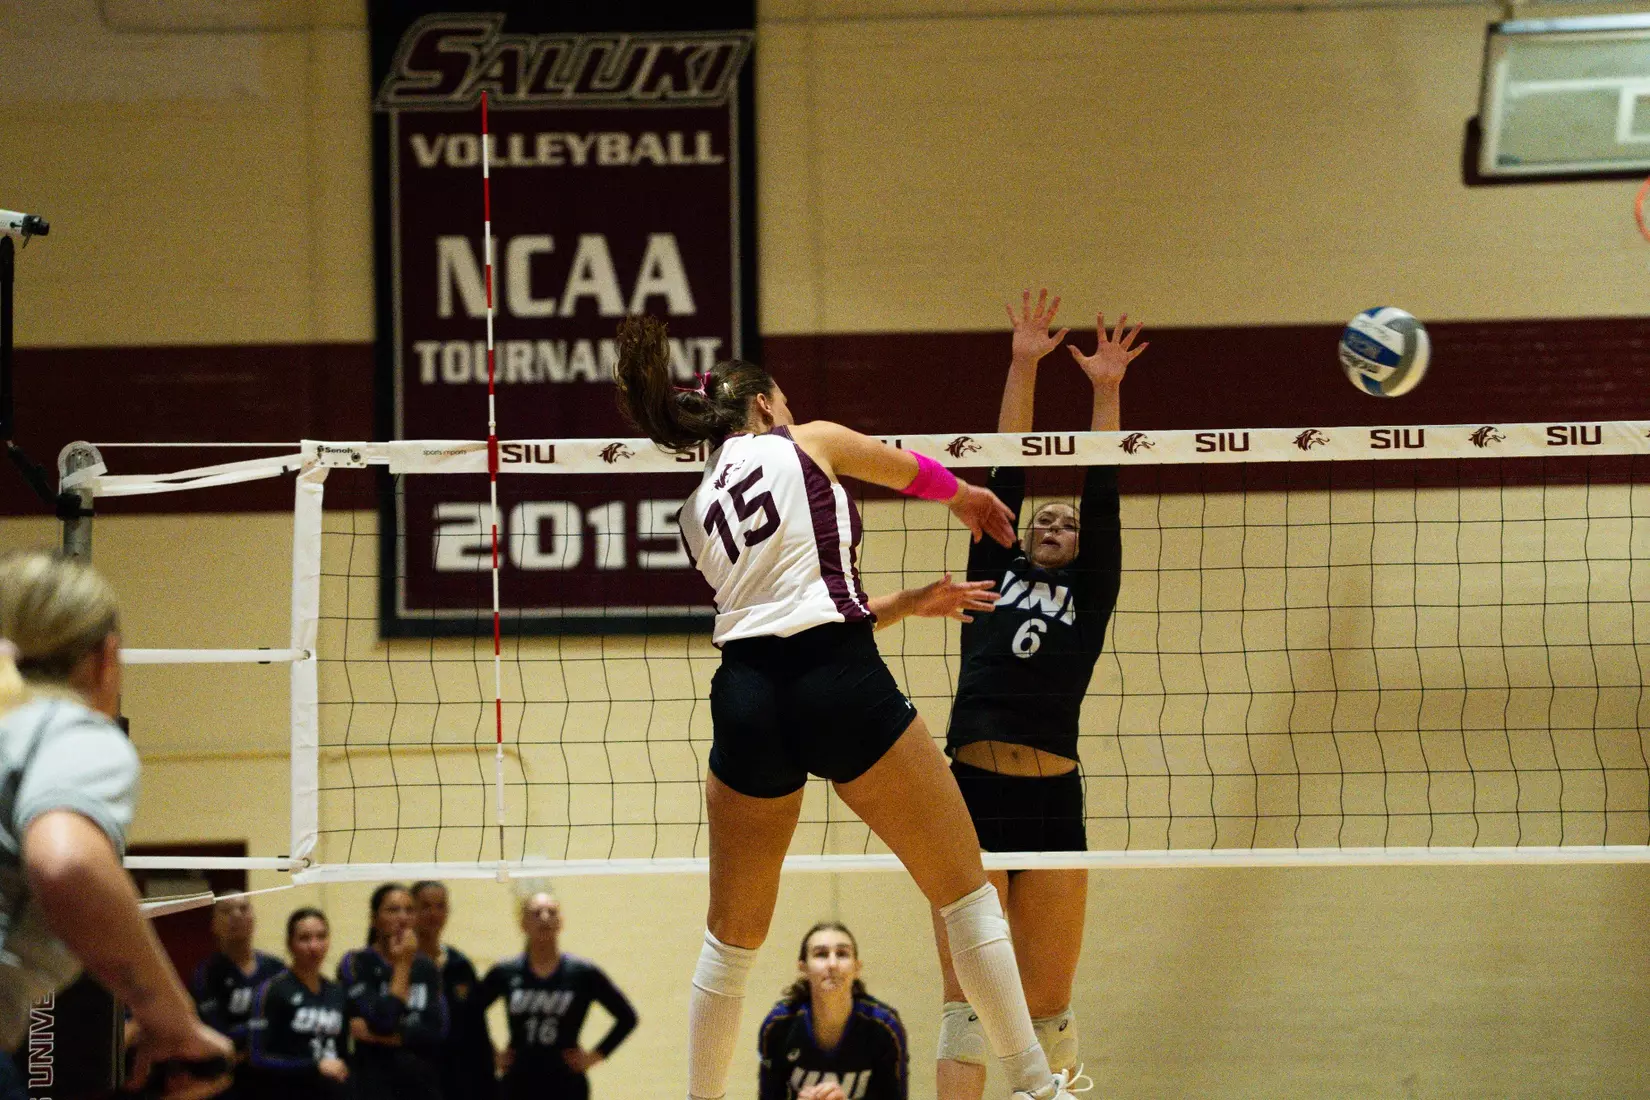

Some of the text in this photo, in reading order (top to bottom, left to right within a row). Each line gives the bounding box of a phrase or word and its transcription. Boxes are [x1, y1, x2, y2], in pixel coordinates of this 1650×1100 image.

[374, 12, 755, 111] SALUKI
[410, 131, 725, 168] VOLLEYBALL
[436, 233, 697, 320] NCAA
[413, 336, 722, 384] TOURNANT
[501, 444, 555, 464] SIU
[1022, 436, 1076, 456] SIU
[1196, 432, 1250, 452] SIU
[1370, 429, 1425, 449] SIU
[1547, 426, 1602, 446] SIU
[703, 465, 781, 565] 15
[432, 500, 697, 571] 2015
[1012, 618, 1047, 658] 6
